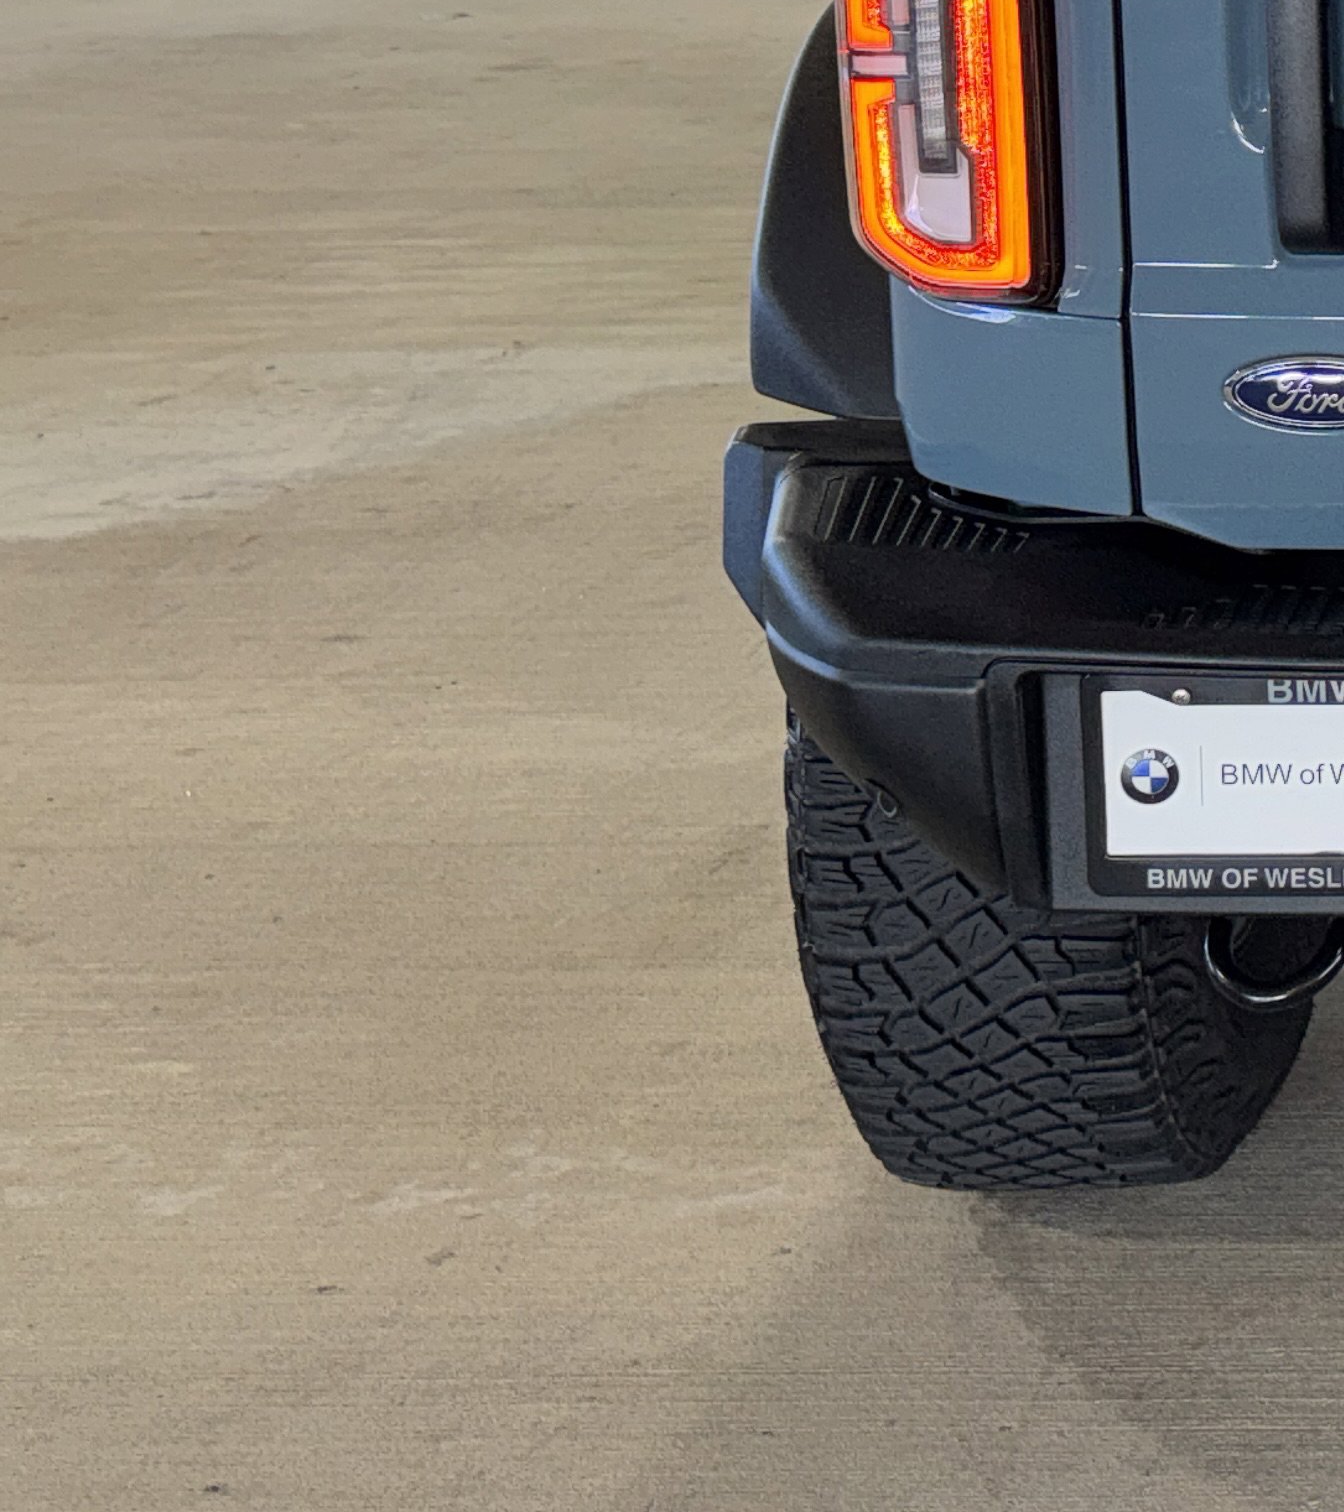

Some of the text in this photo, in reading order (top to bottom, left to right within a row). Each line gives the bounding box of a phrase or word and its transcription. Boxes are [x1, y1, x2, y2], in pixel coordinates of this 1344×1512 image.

[1221, 763, 1293, 785] BMW
[1299, 763, 1325, 785] of
[1147, 868, 1213, 888] BMW
[1221, 868, 1258, 888] OF
